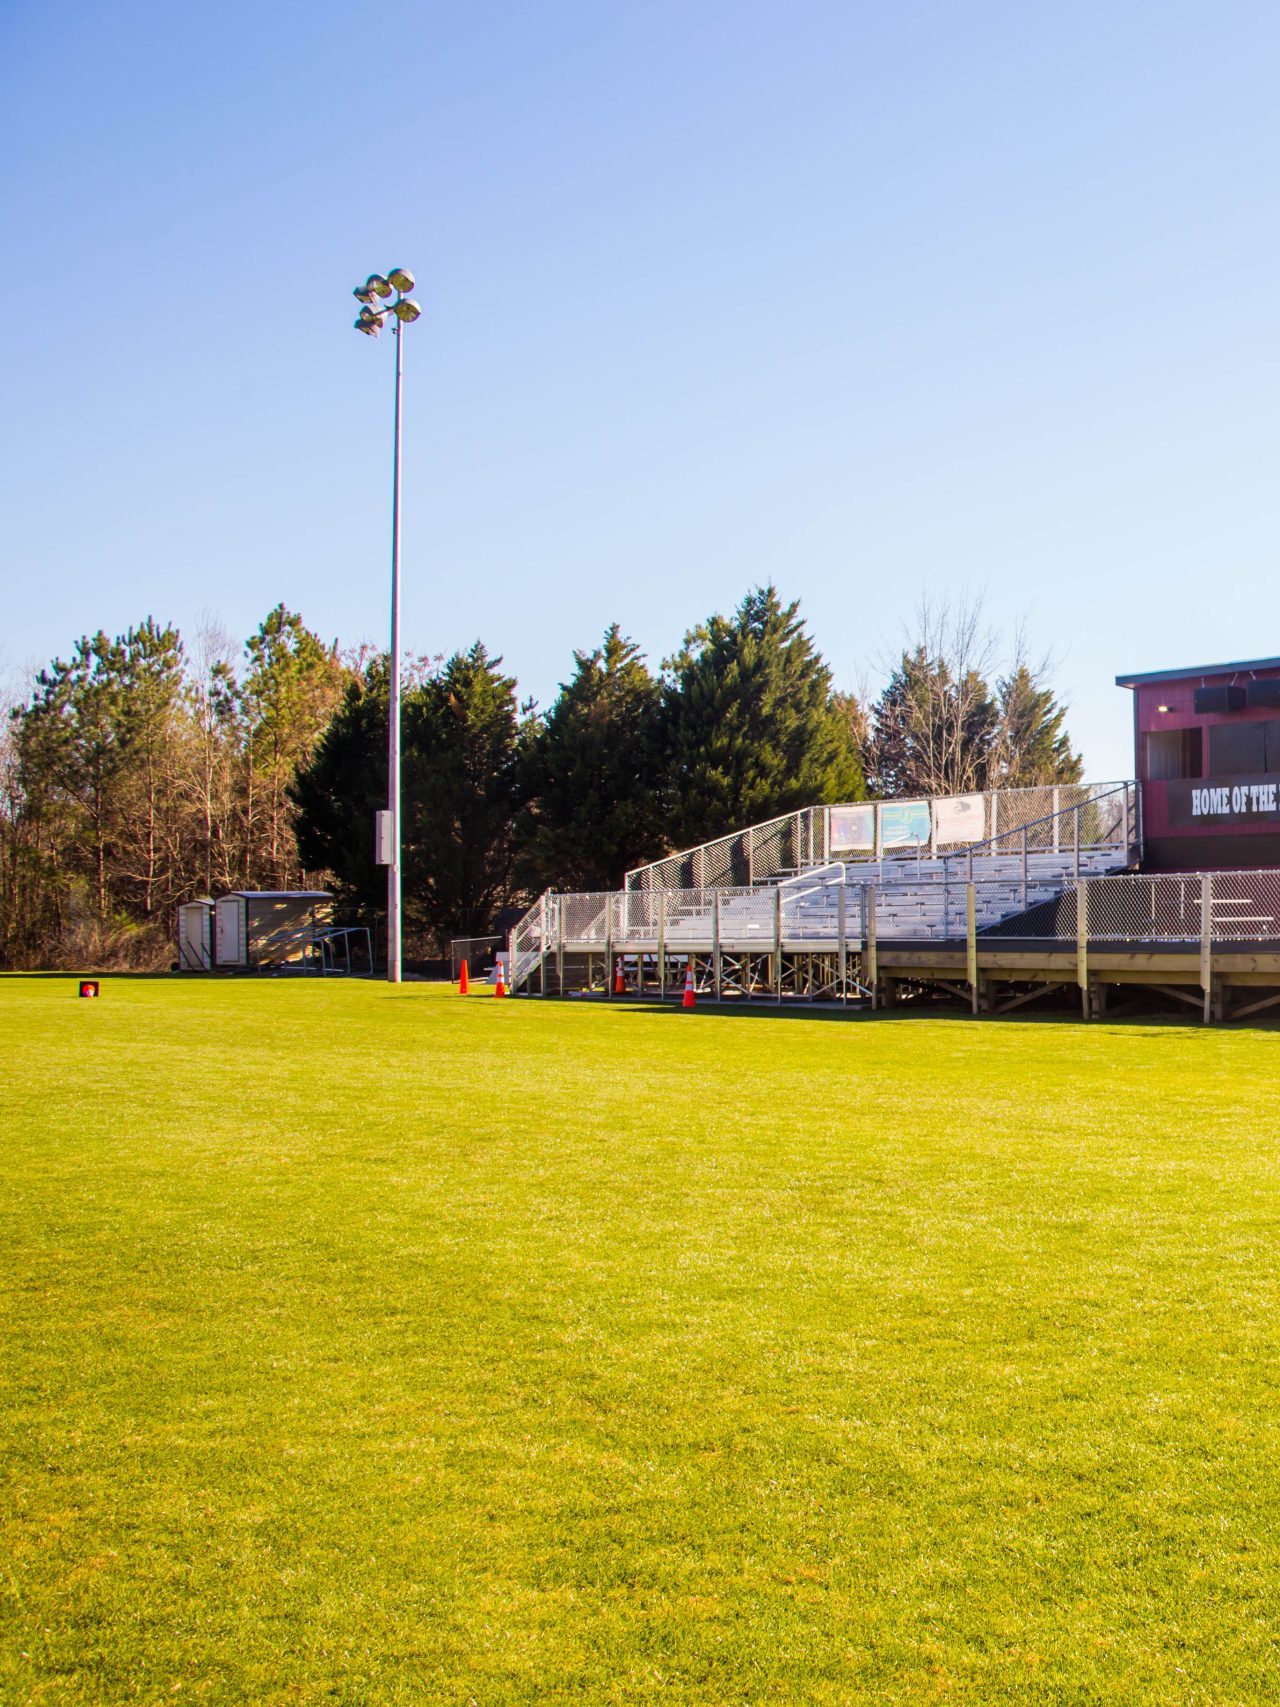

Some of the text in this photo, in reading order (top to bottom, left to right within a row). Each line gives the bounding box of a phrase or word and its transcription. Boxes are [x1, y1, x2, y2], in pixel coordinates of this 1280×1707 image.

[1192, 787, 1230, 816] HOME
[1232, 785, 1249, 814] OF
[1250, 784, 1277, 813] THE
